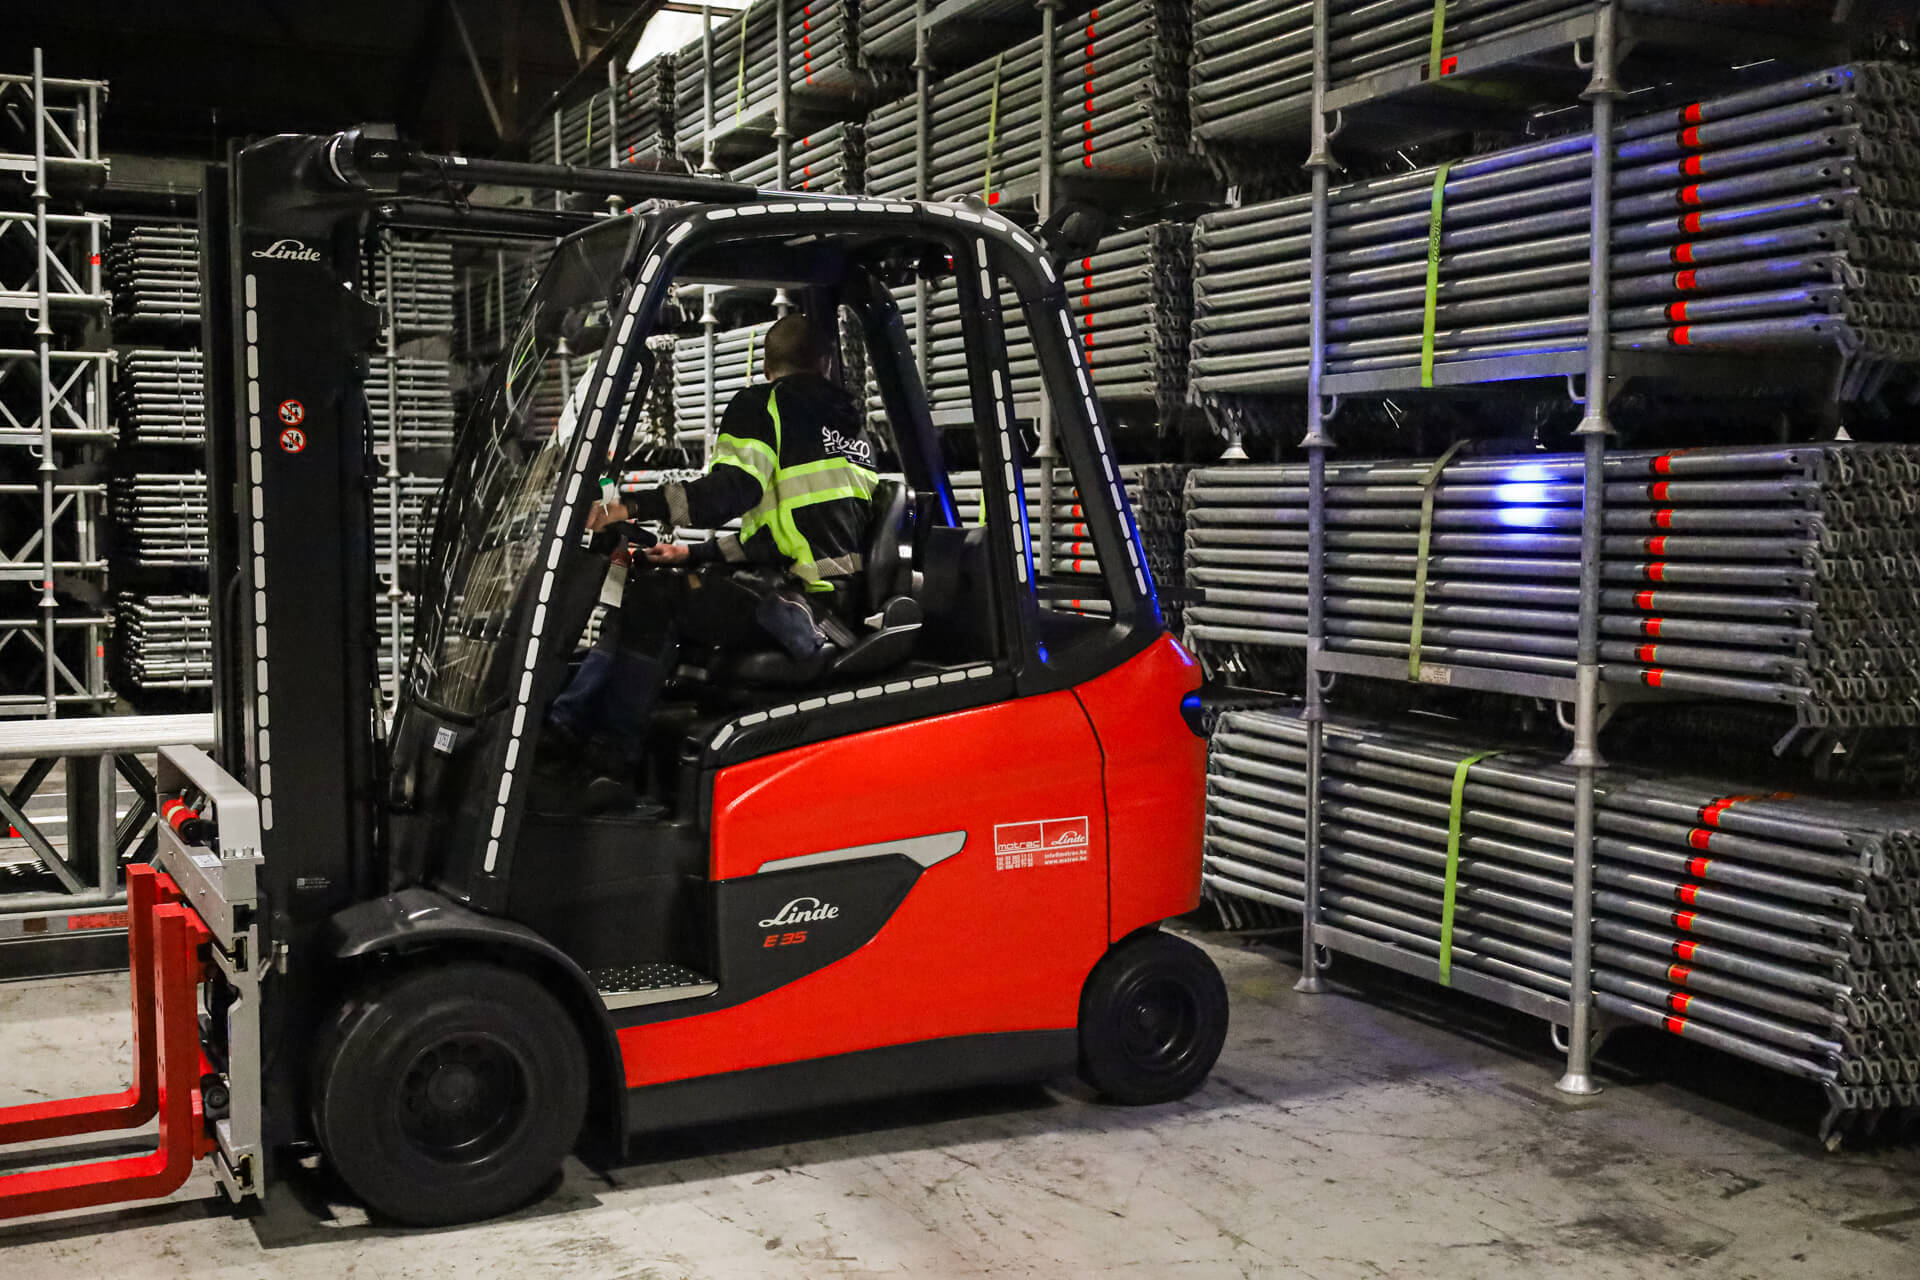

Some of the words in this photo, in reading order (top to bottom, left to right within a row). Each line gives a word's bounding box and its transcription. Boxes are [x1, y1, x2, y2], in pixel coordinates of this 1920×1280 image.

[251, 239, 321, 262] Linde
[1051, 830, 1086, 846] Linde
[758, 896, 840, 928] Linde
[763, 934, 780, 948] E
[780, 930, 808, 946] 35
